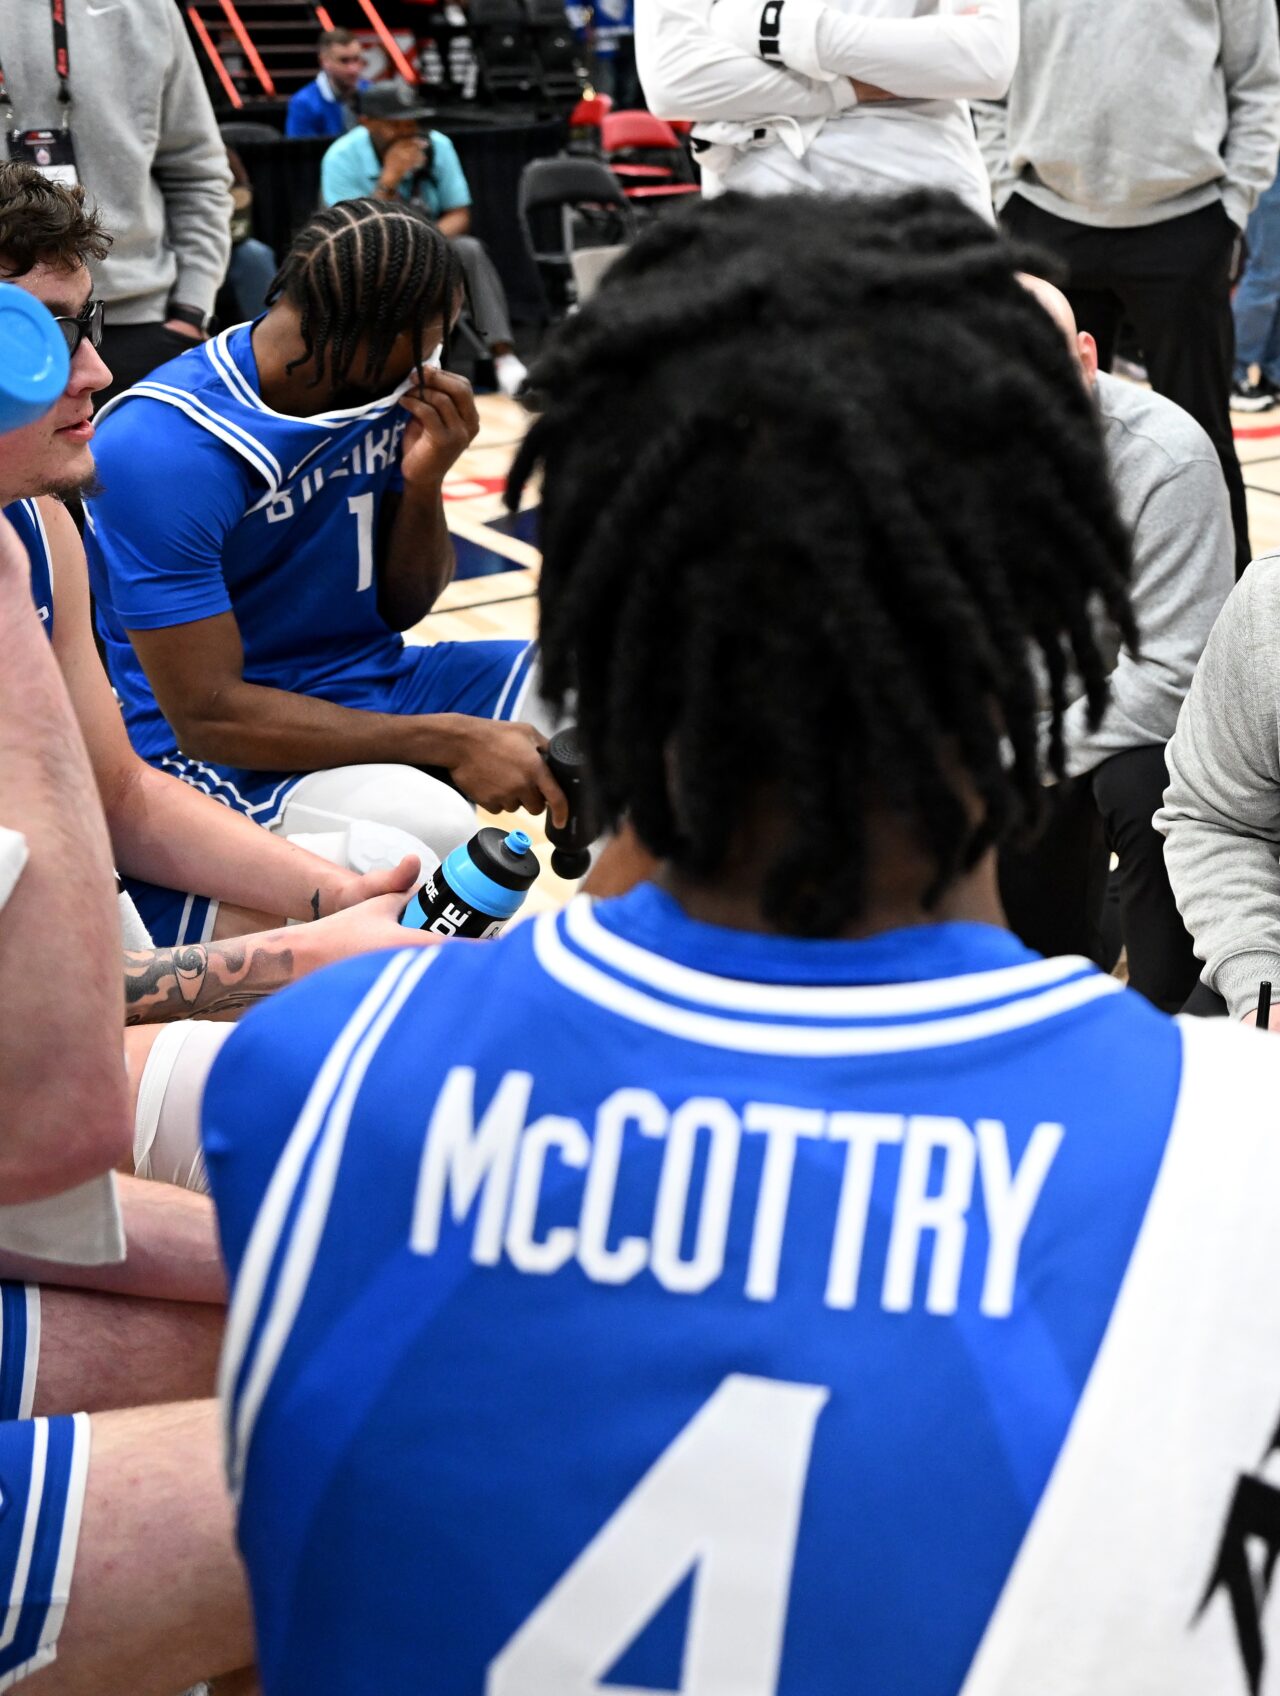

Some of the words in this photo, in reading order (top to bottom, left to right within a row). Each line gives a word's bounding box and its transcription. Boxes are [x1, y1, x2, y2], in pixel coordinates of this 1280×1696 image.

[347, 492, 374, 592] 1
[409, 1065, 1066, 1319] McCOTTRY
[487, 1373, 831, 1696] 4
